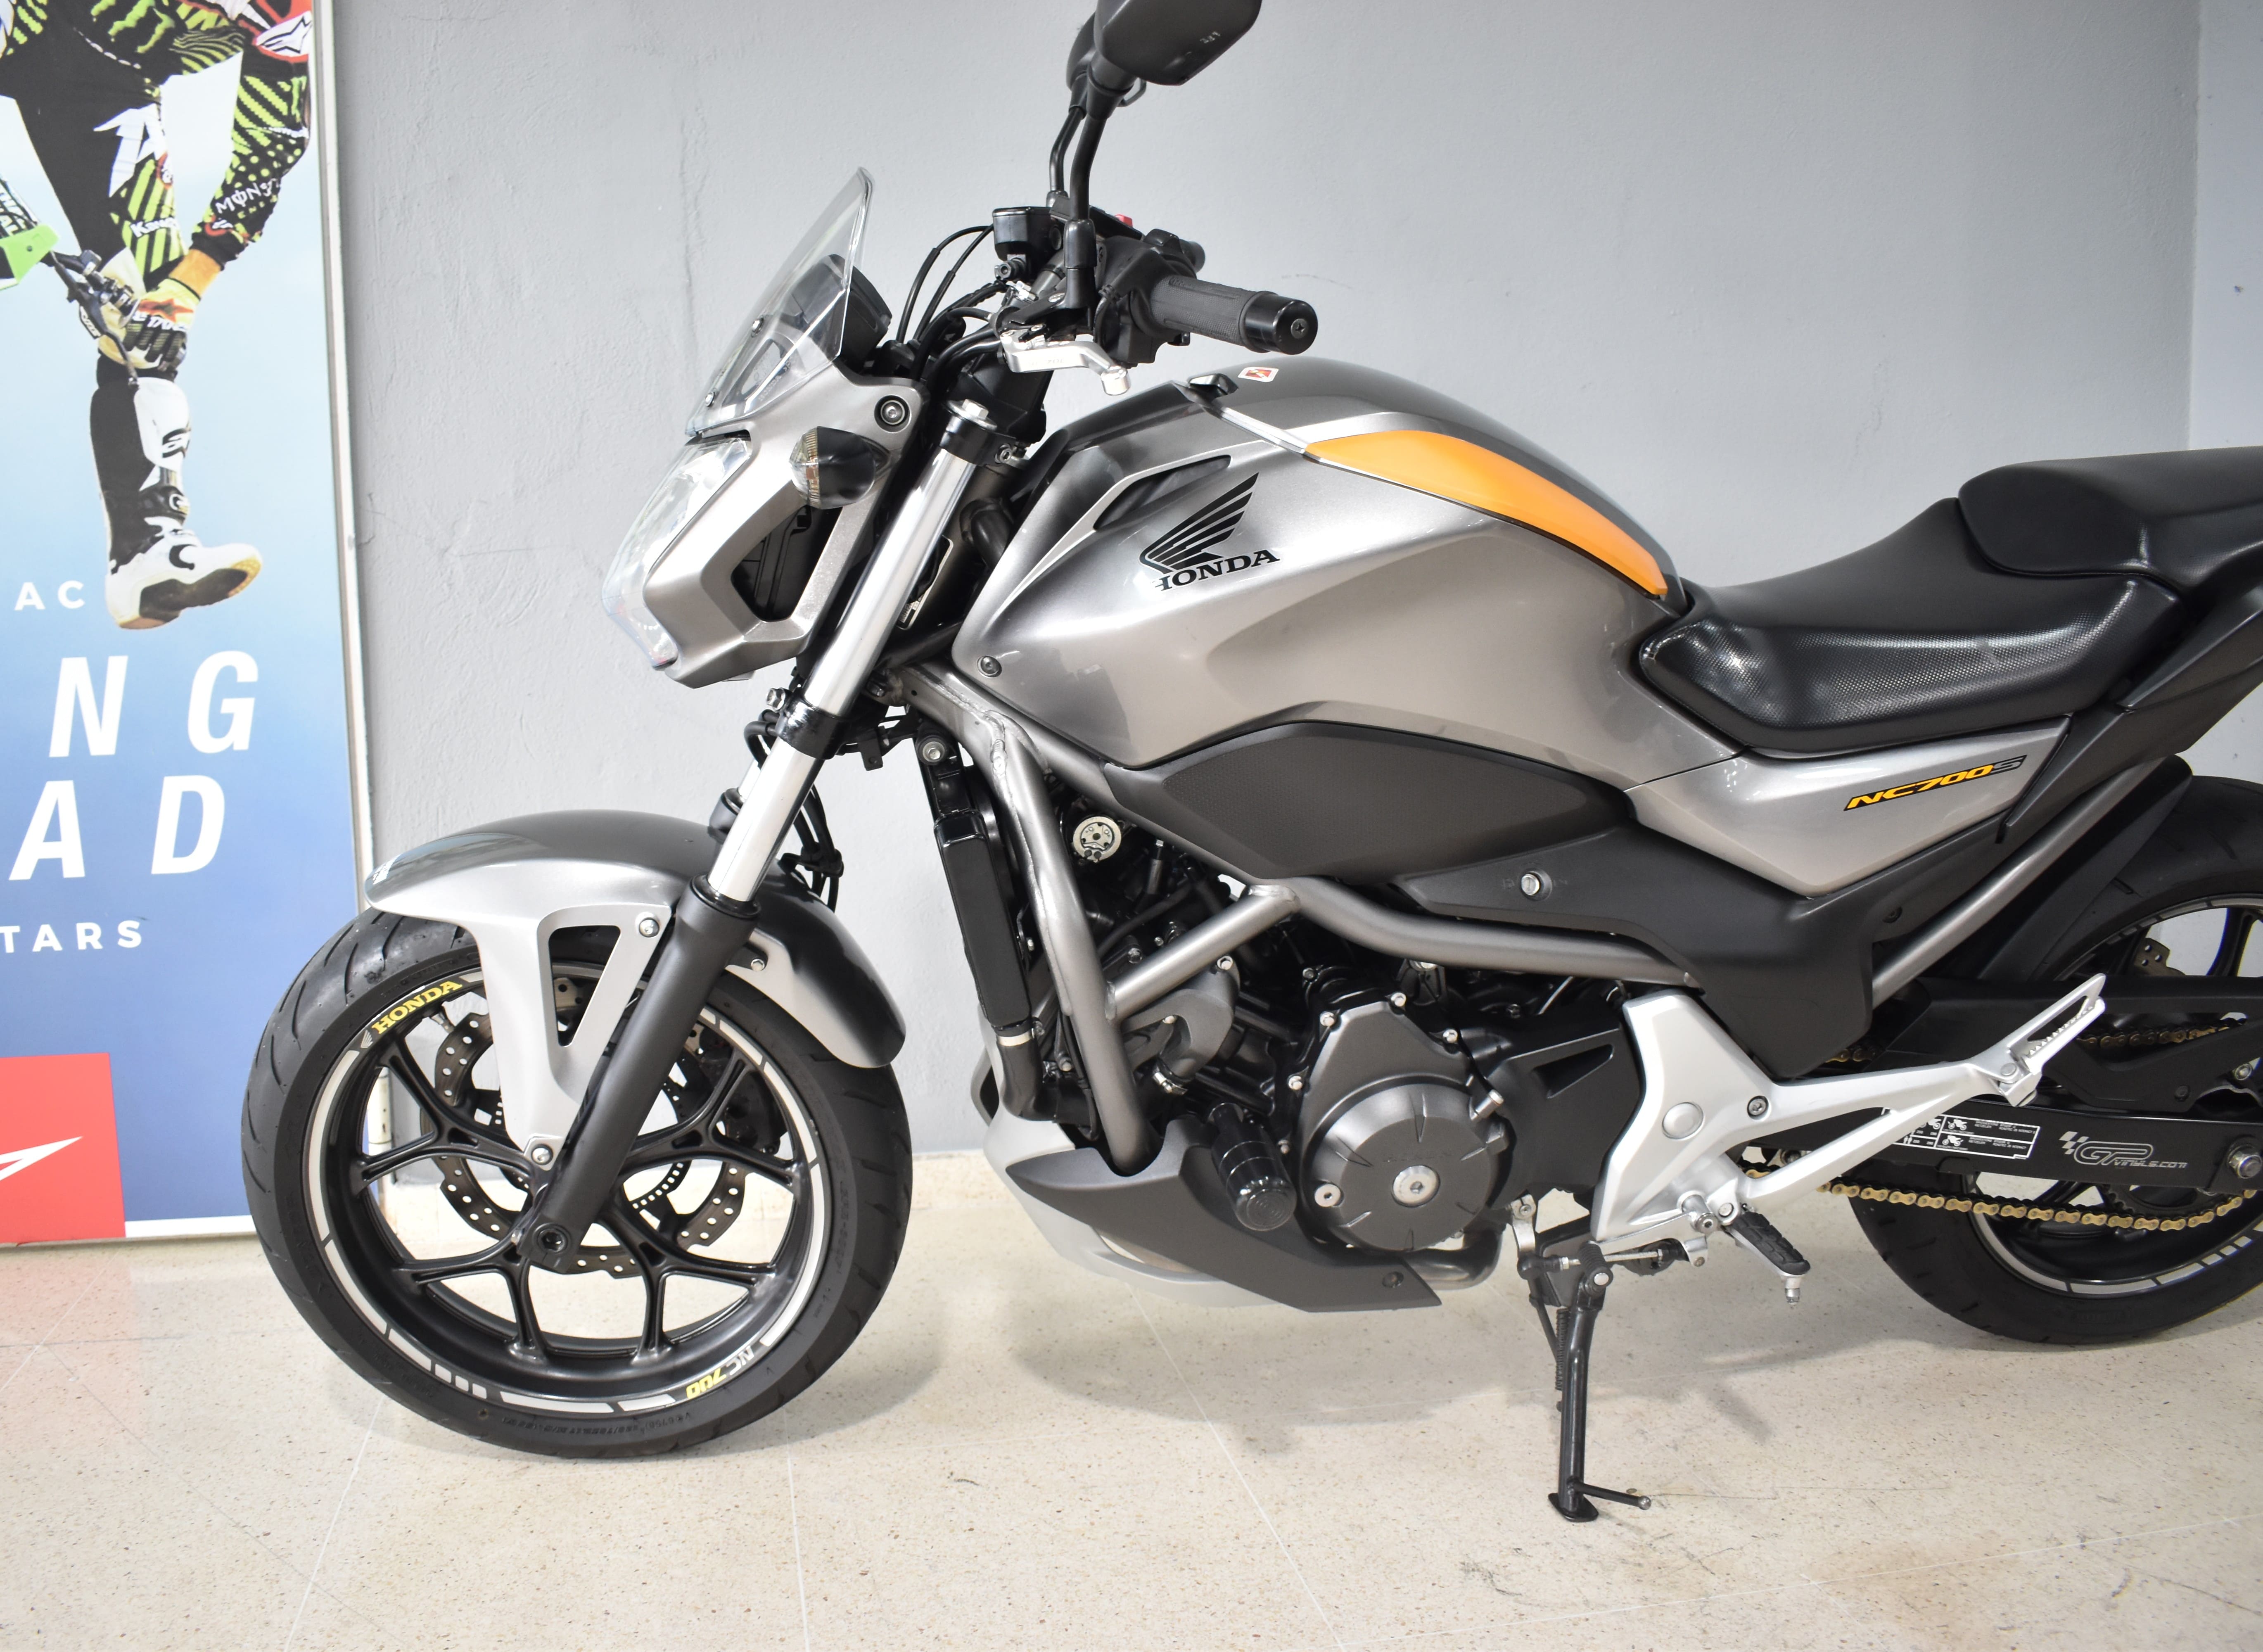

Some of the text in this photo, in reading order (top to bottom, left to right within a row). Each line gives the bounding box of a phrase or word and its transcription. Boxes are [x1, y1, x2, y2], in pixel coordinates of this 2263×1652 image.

[1844, 755, 2027, 811] NC700S
[0, 921, 142, 953] TARS
[372, 980, 463, 1034] HONDA
